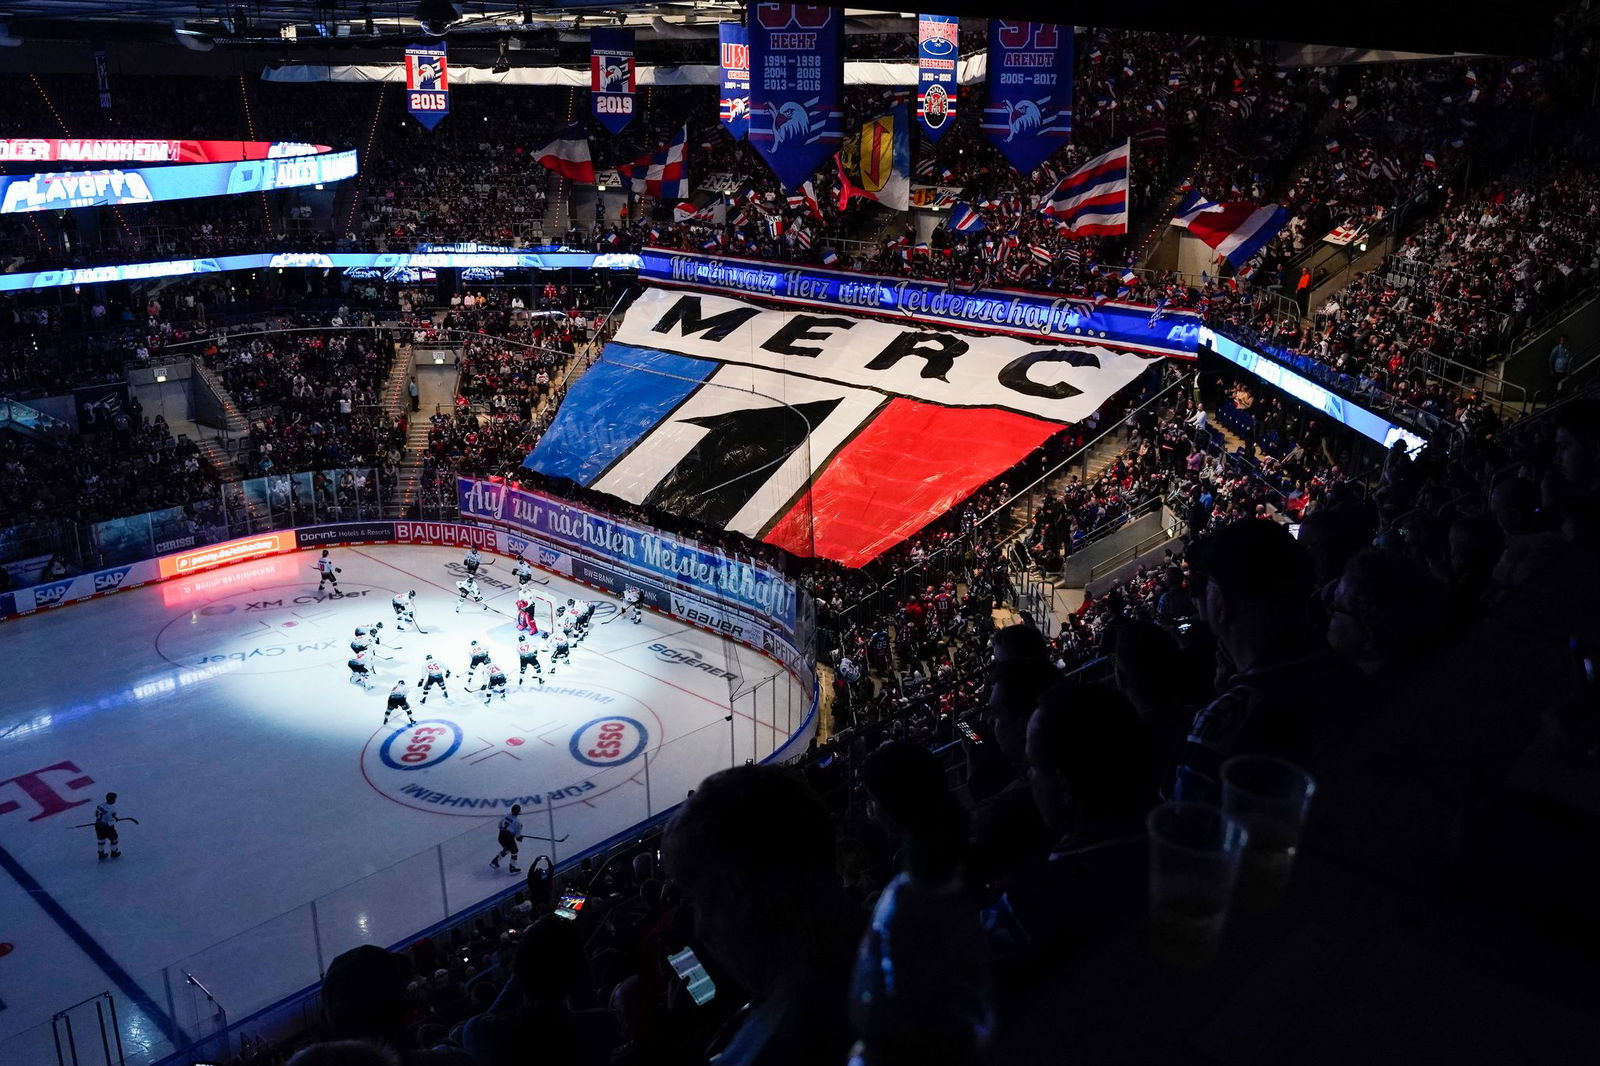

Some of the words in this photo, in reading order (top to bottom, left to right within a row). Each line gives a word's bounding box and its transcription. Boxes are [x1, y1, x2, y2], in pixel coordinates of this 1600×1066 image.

[770, 32, 817, 50] HECHT
[721, 43, 749, 70] UD
[1003, 52, 1055, 68] ARENDT
[763, 67, 787, 79] 2004
[796, 68, 821, 79] 2005
[410, 93, 447, 110] 2015
[596, 95, 634, 114] 2019
[0, 139, 52, 161] DLER
[58, 139, 171, 161] MANNHEIM
[1, 169, 153, 213] PLAYOFFS
[670, 255, 700, 283] Mit
[708, 261, 776, 297] Einsatz,
[784, 270, 830, 299] Herz
[838, 280, 881, 307] und
[651, 294, 1101, 400] MERC
[155, 535, 196, 553] CHRISSI
[300, 530, 337, 541] Dorint
[338, 529, 361, 538] Hotels
[366, 527, 391, 536] Resorts
[396, 523, 497, 548] BAUHAUS
[190, 539, 274, 565] penny.de/eishockey
[463, 480, 508, 520] Auf
[512, 497, 543, 525] zur
[548, 504, 635, 560] nächsten
[641, 532, 793, 620] Meisterschaft!
[508, 540, 525, 555] SAP
[538, 552, 556, 567] SAP
[95, 571, 124, 590] SAP
[598, 571, 615, 586] BANK
[35, 585, 67, 603] SAP
[245, 598, 284, 612] XM
[293, 589, 372, 606] Cyber
[197, 645, 287, 665] Cyber
[297, 639, 338, 654] XM
[647, 642, 739, 681] SCHERER
[400, 726, 448, 763] ESSO
[587, 721, 626, 759] ESSO
[400, 782, 543, 809] MANNHEIM!
[547, 780, 598, 800] FÜR
